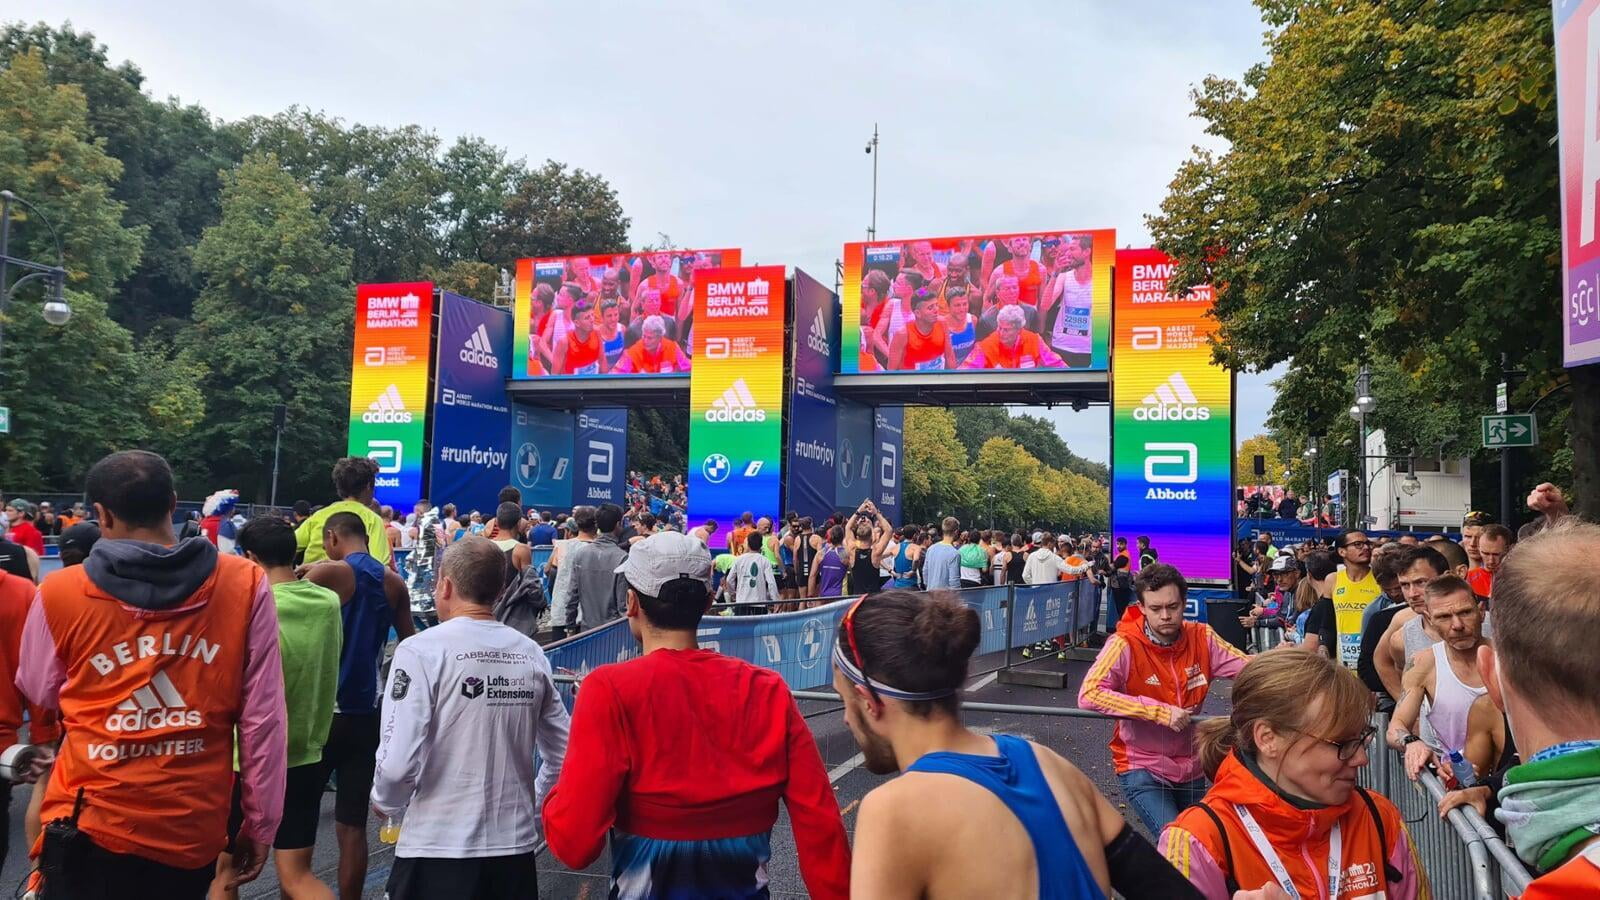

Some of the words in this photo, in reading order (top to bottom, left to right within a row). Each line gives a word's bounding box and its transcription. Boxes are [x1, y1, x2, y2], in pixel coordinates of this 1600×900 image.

[707, 282, 745, 296] BMW
[367, 296, 400, 309] BMW
[707, 296, 745, 307] BERLIN
[367, 309, 399, 319] BERLIN
[706, 306, 769, 317] MARATHON
[366, 318, 418, 328] MARATHON
[807, 334, 830, 356] adidas
[459, 348, 498, 368] adidas
[362, 408, 412, 423] adidas
[705, 406, 766, 422] adidas
[1133, 403, 1210, 420] adidas
[440, 445, 508, 470] #runforjoy
[374, 477, 399, 486] bbott
[587, 486, 612, 499] Abbott
[1145, 487, 1198, 500] Abbott
[89, 633, 221, 676] BERLIN
[456, 651, 500, 661] CABBAGE
[502, 652, 528, 660] PATCH
[487, 675, 509, 686] Lofts
[510, 676, 525, 686] and
[487, 687, 535, 699] Extensions
[105, 708, 202, 731] adidas
[88, 738, 206, 761] VOLUNTEER
